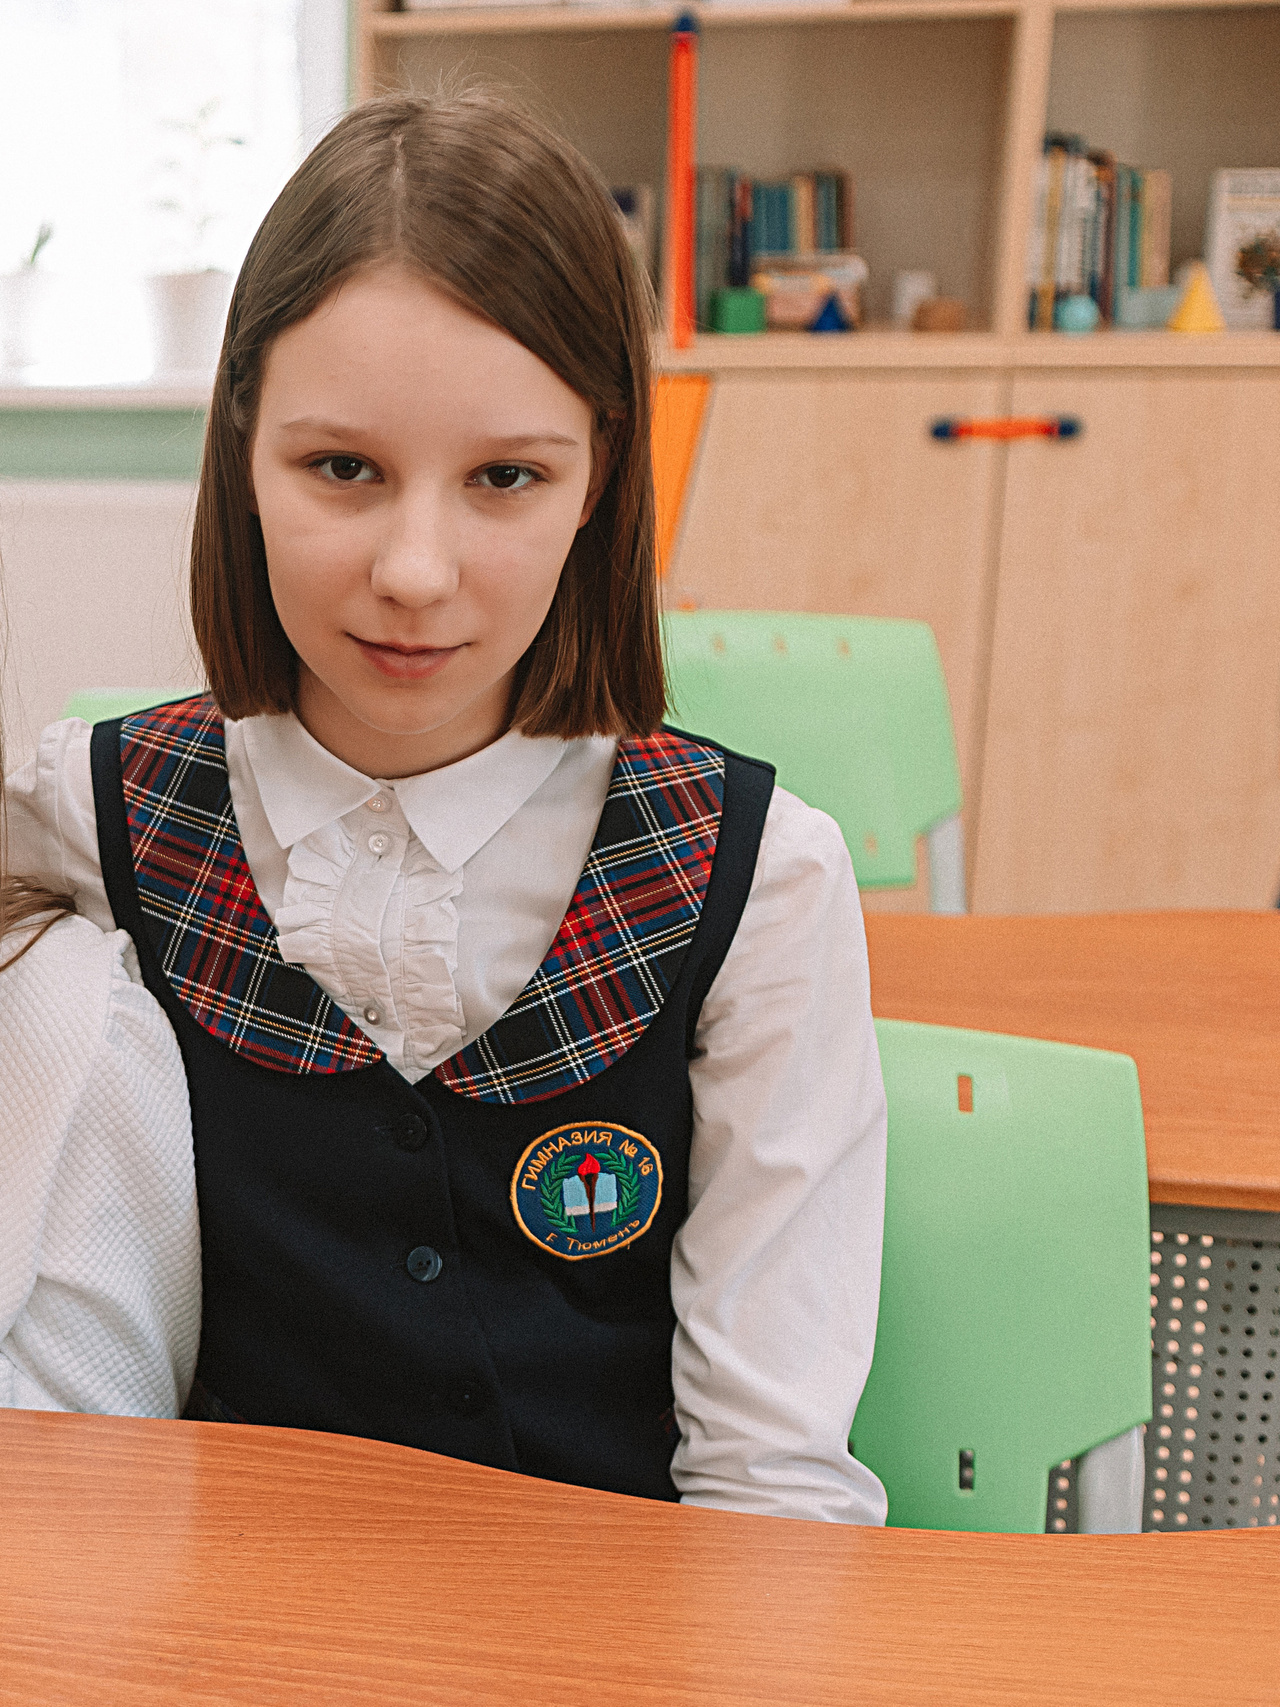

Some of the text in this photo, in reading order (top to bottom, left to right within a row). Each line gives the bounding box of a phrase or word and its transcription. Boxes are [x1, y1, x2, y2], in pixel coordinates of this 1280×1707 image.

[521, 1130, 654, 1190] ГИМНАЗИЯ № 16
[566, 1219, 640, 1251] Тюмень
